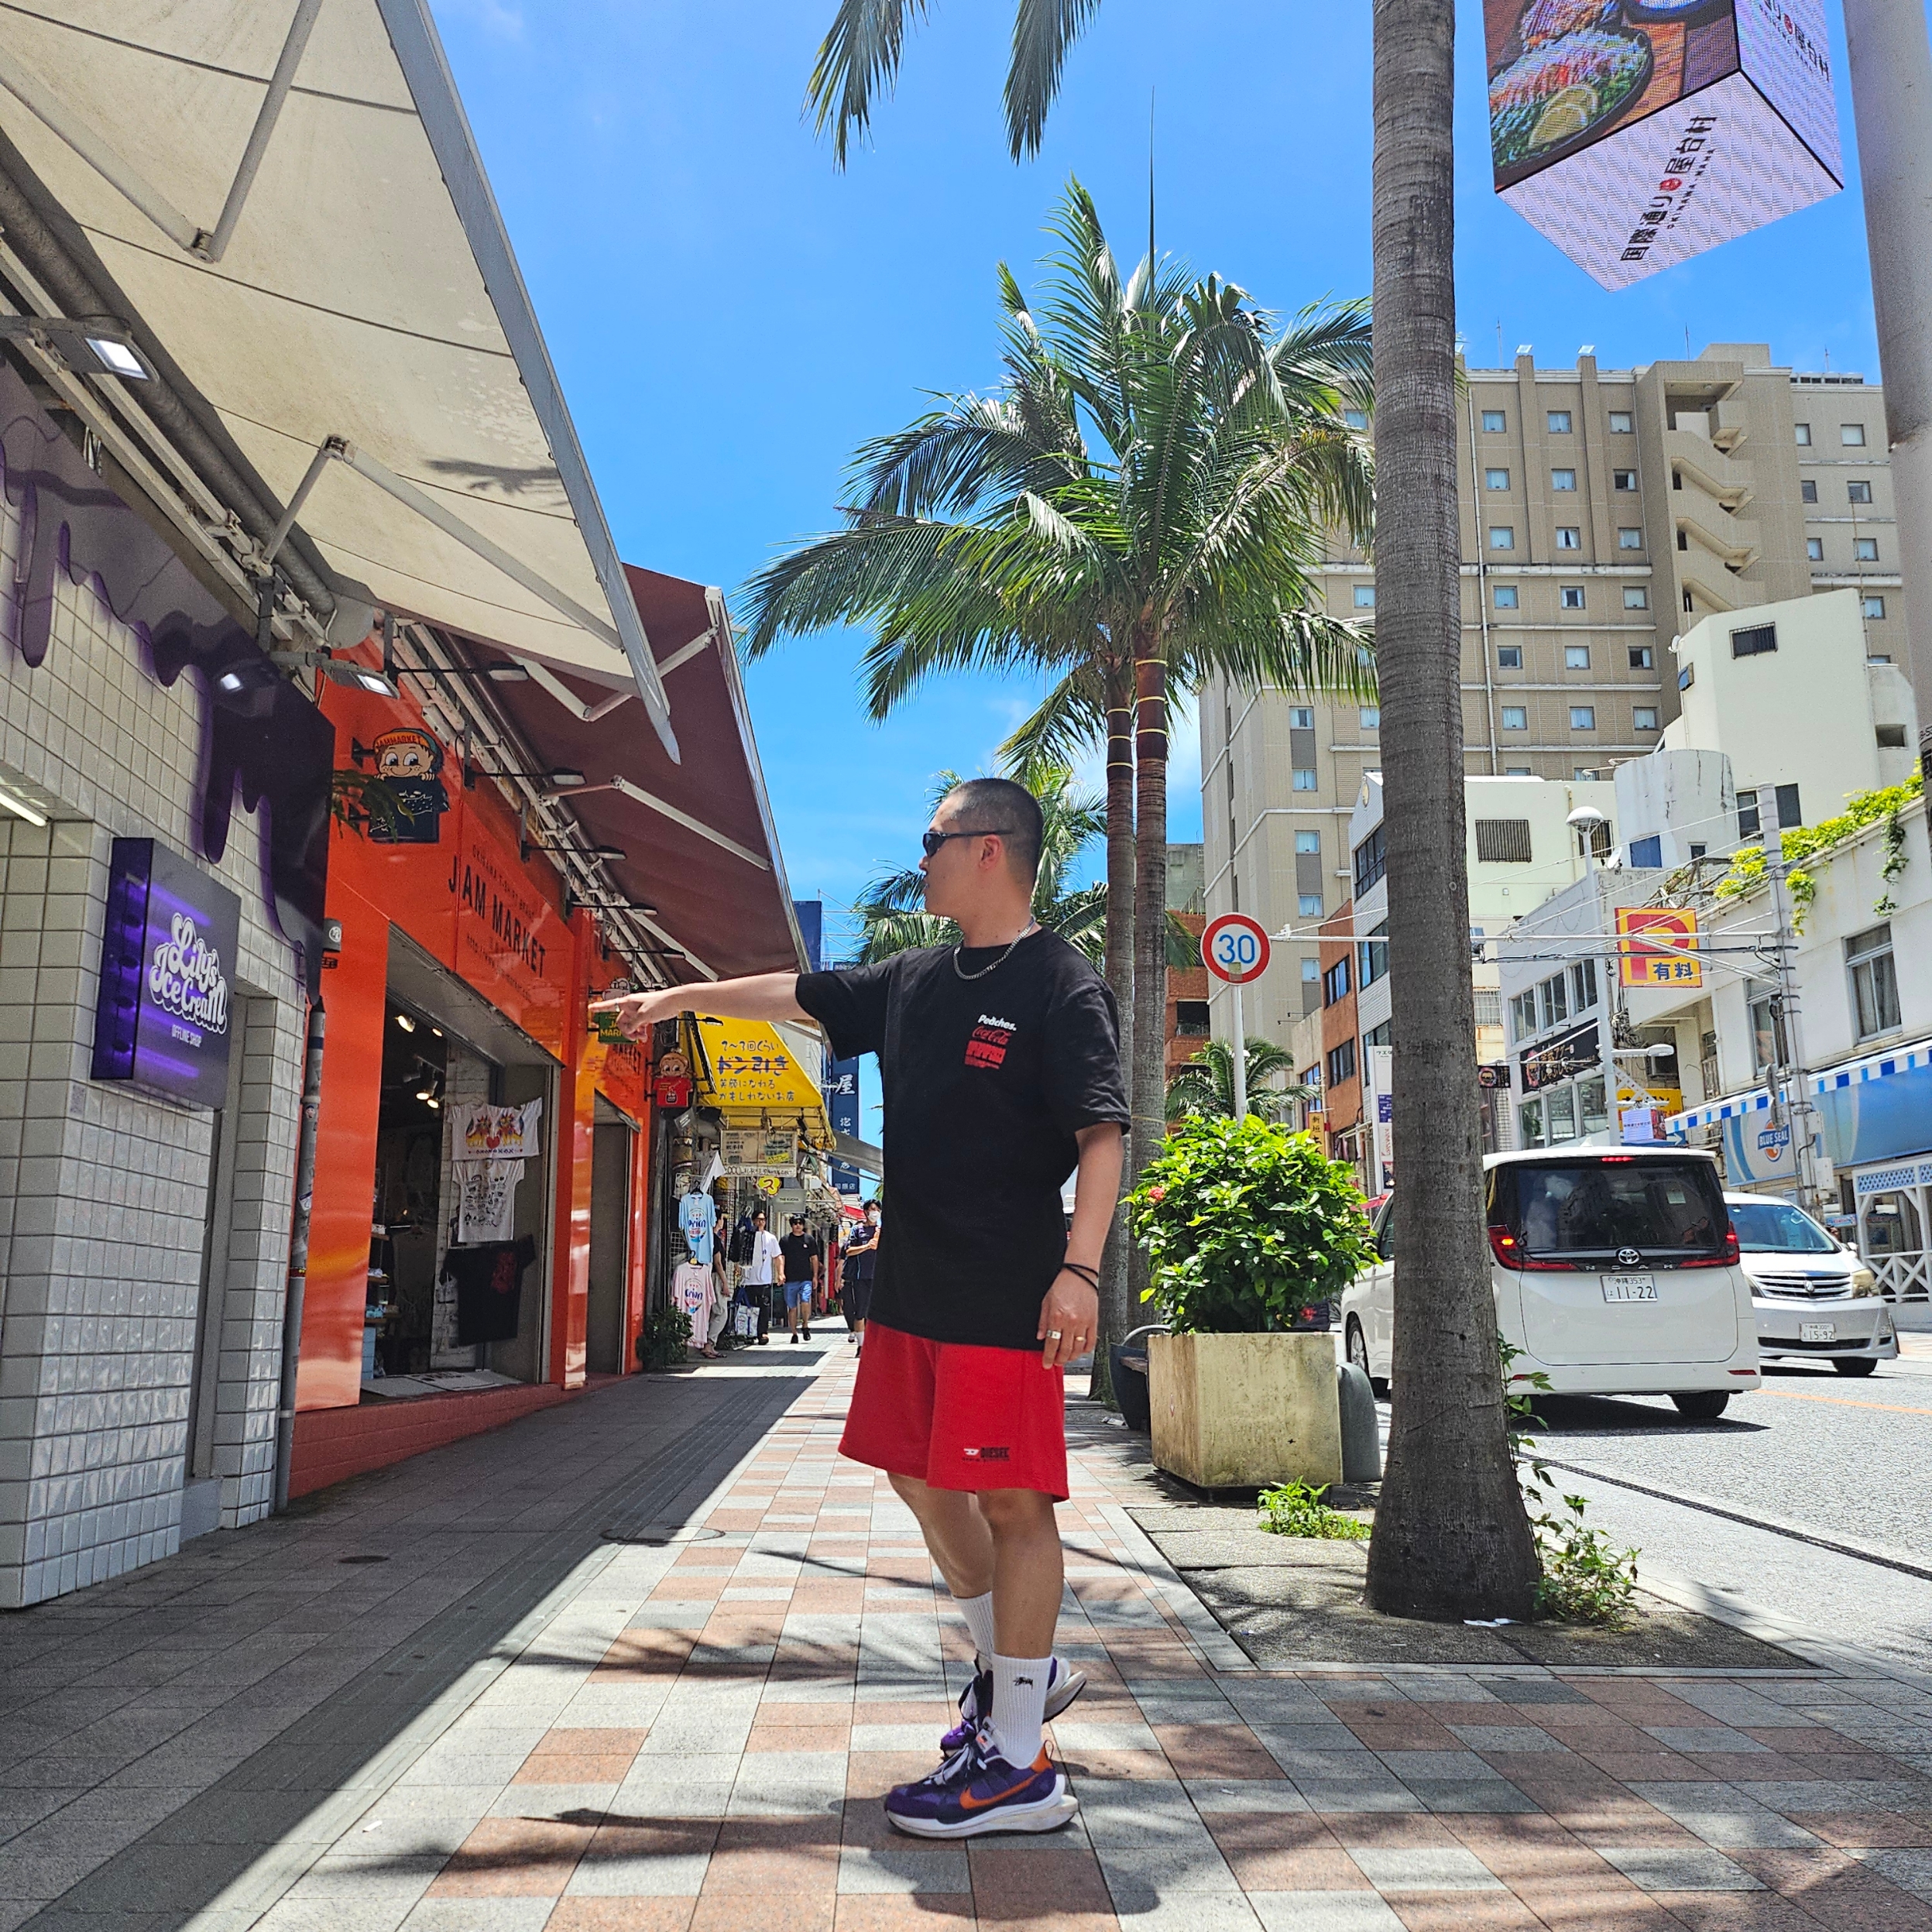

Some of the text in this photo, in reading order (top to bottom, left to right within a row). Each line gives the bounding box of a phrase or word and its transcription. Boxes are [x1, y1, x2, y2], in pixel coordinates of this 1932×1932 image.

[448, 855, 486, 919] JAM
[492, 894, 547, 979] MARKET
[168, 912, 218, 993] Lily's
[1218, 934, 1255, 964] 30
[149, 942, 182, 1004] Ice
[1652, 962, 1694, 980] 有料
[977, 1014, 1017, 1031] Peaches.
[720, 1079, 775, 1089] 笑顔になれる
[836, 1074, 856, 1095] 屋
[719, 1091, 794, 1102] かもしれないお店
[1759, 1130, 1789, 1146] BLUE SEAL
[1617, 1286, 1655, 1299] 11-22
[1809, 1330, 1835, 1340] 15-92
